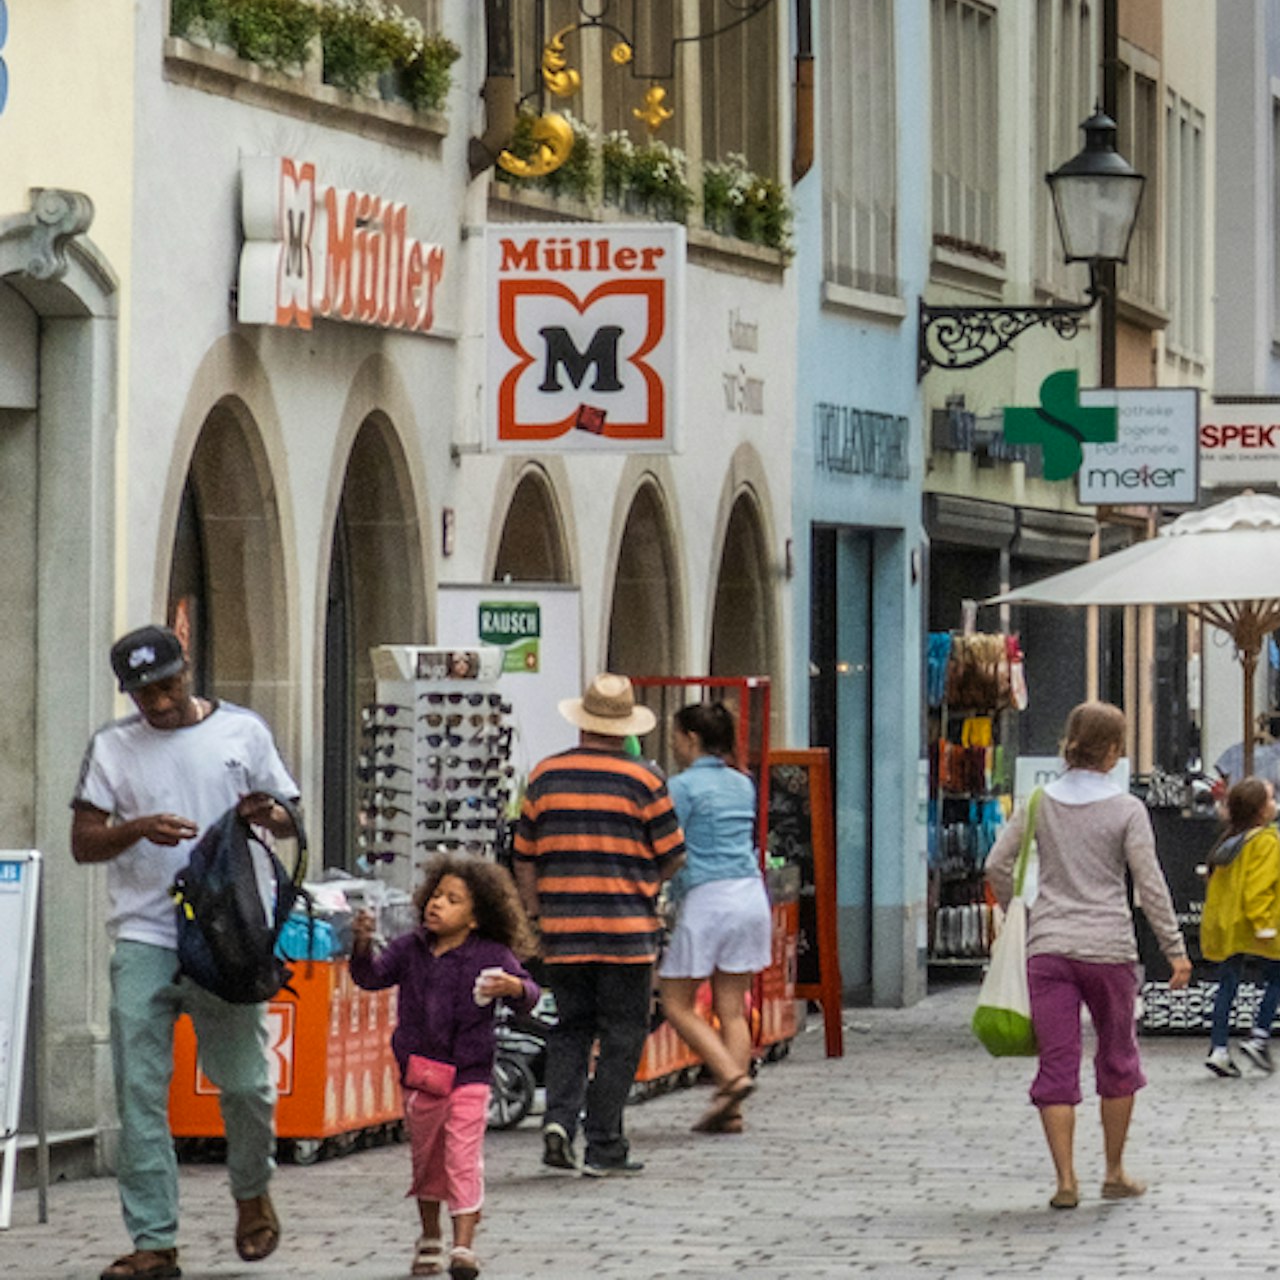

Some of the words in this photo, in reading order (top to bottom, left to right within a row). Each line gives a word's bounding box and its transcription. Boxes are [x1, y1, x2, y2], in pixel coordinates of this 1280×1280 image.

[286, 209, 303, 278] M
[321, 186, 444, 331] Müller
[499, 238, 665, 272] Müller
[537, 325, 625, 393] M
[1087, 464, 1186, 488] meier
[481, 611, 537, 634] RAUSCH
